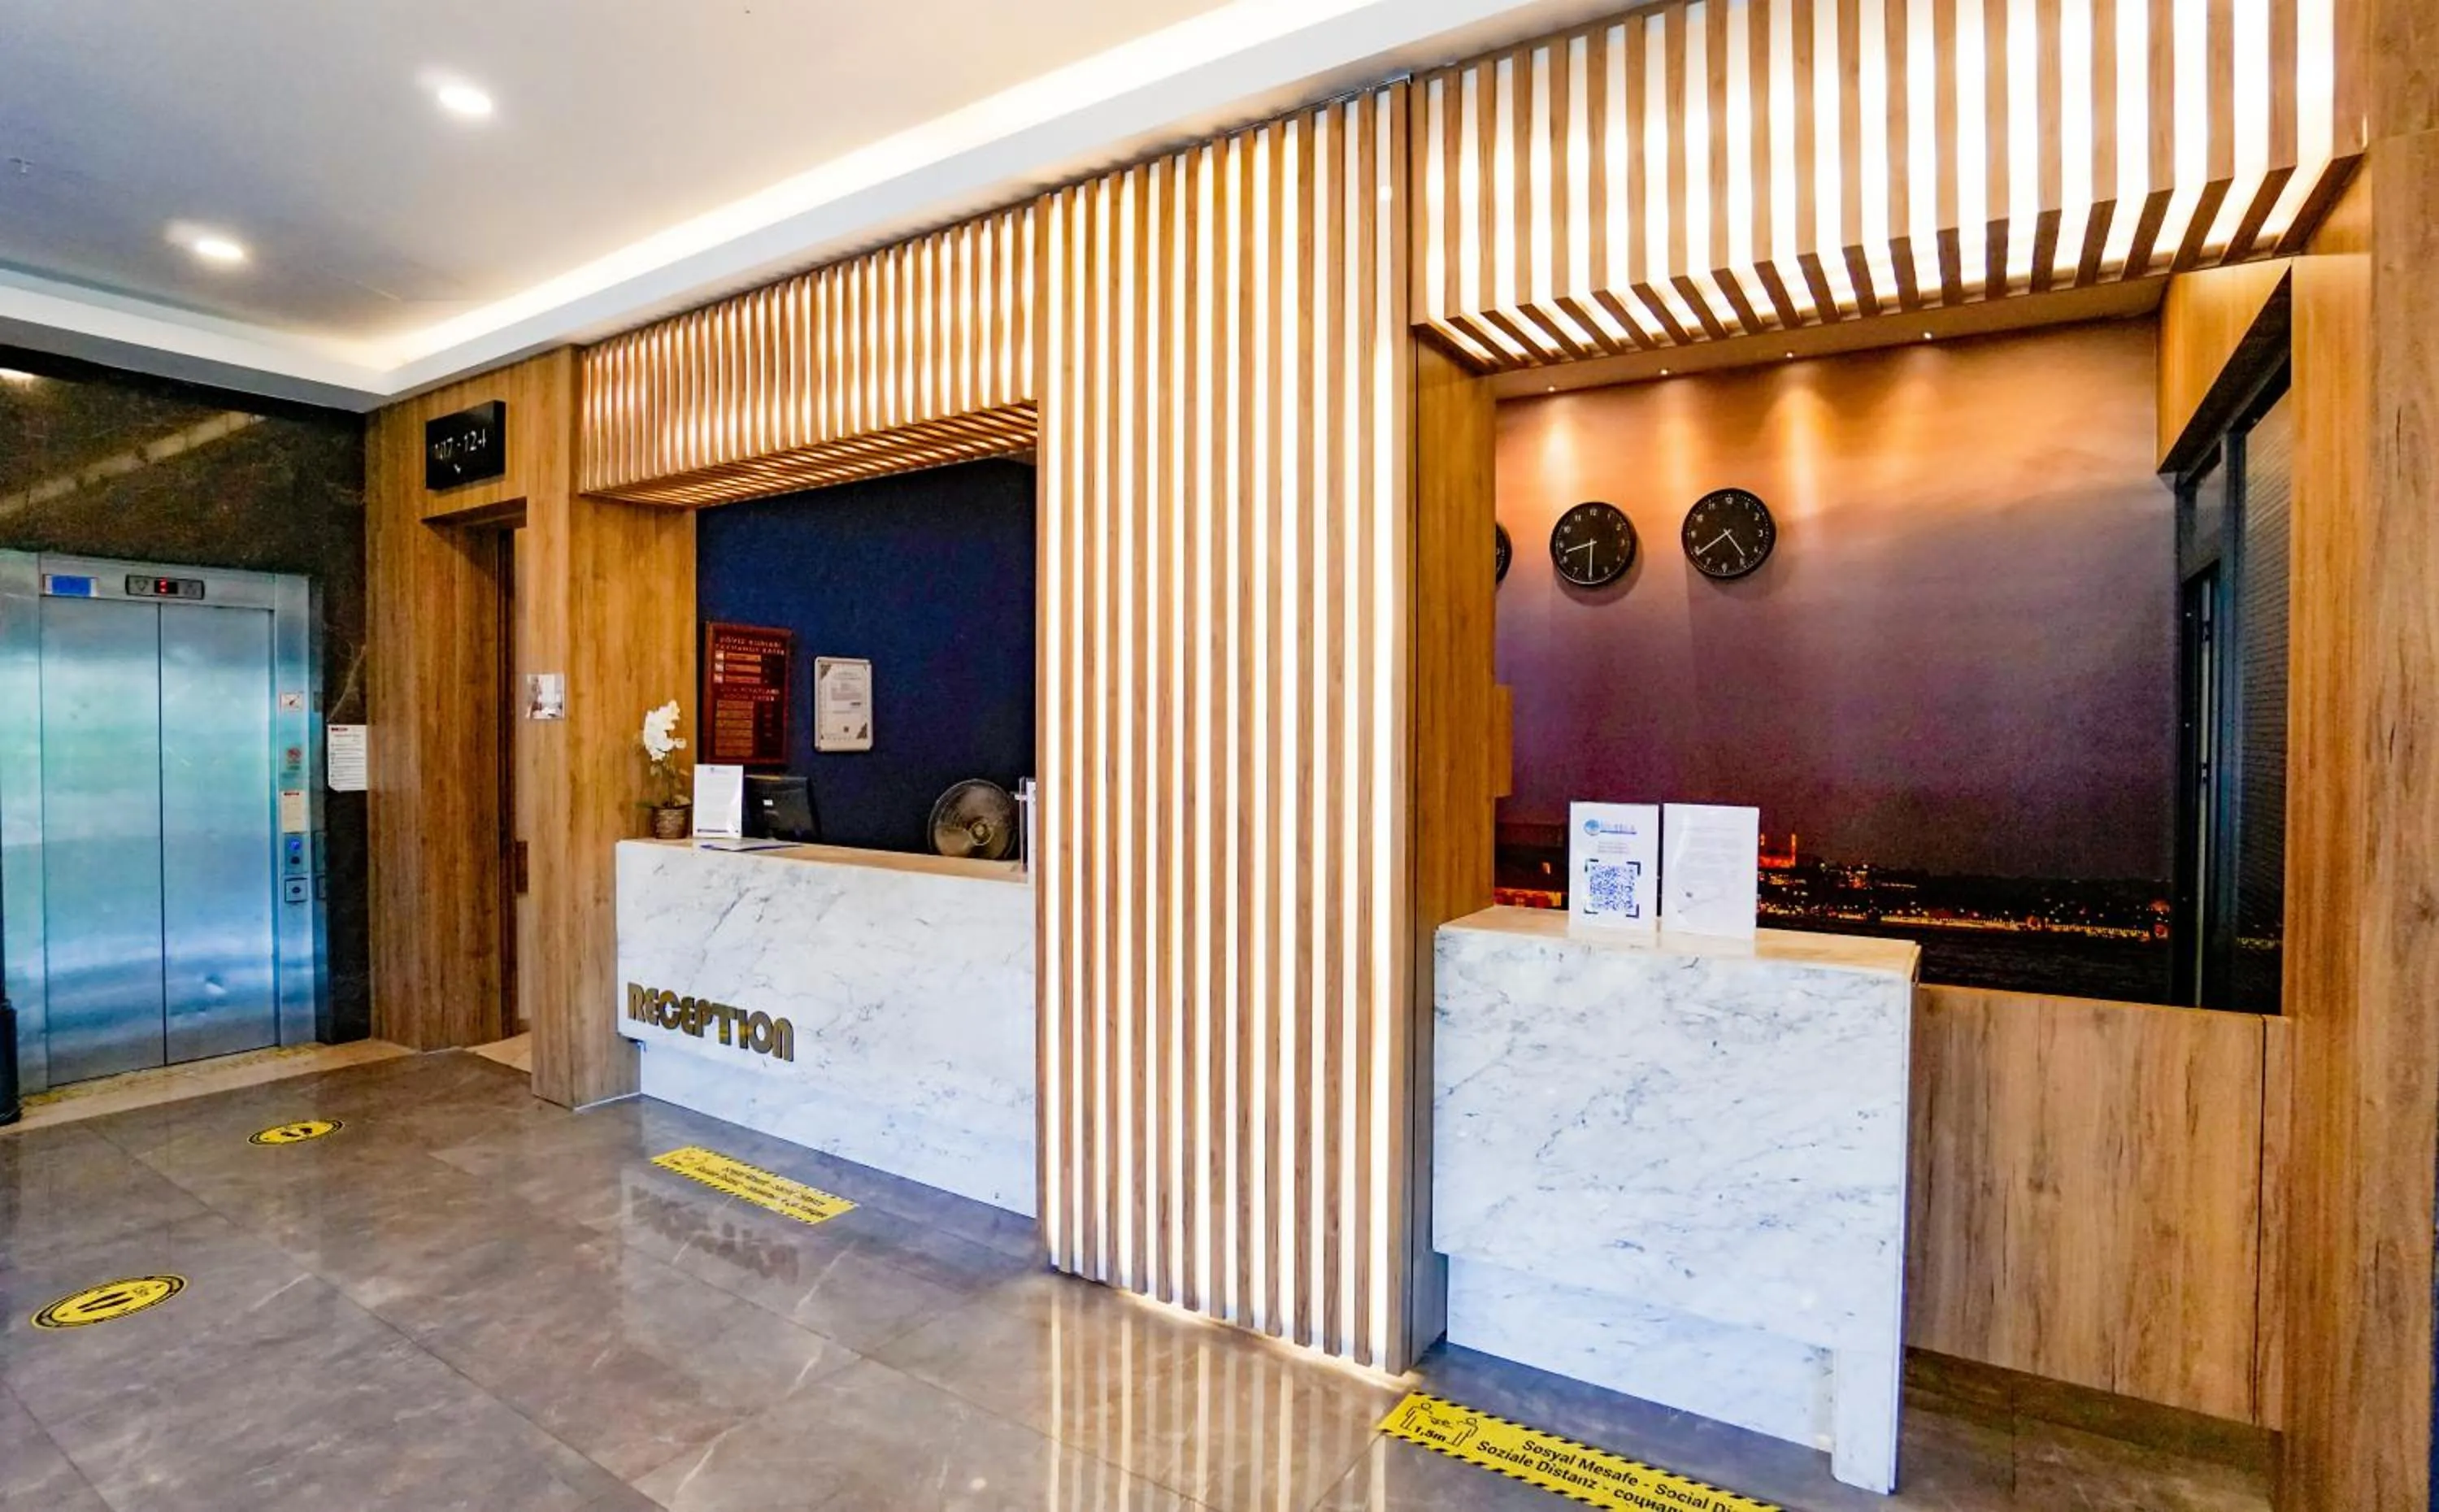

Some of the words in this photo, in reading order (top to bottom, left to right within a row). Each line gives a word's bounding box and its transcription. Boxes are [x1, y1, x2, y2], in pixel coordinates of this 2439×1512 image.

[463, 428, 487, 453] 124
[628, 982, 794, 1062] RECEPTION
[1476, 1440, 1533, 1467] Soziale
[1537, 1461, 1598, 1490] Distanz
[1523, 1440, 1577, 1466] Sosyal
[1578, 1458, 1638, 1487] Mesafe
[1654, 1484, 1710, 1509] Social
